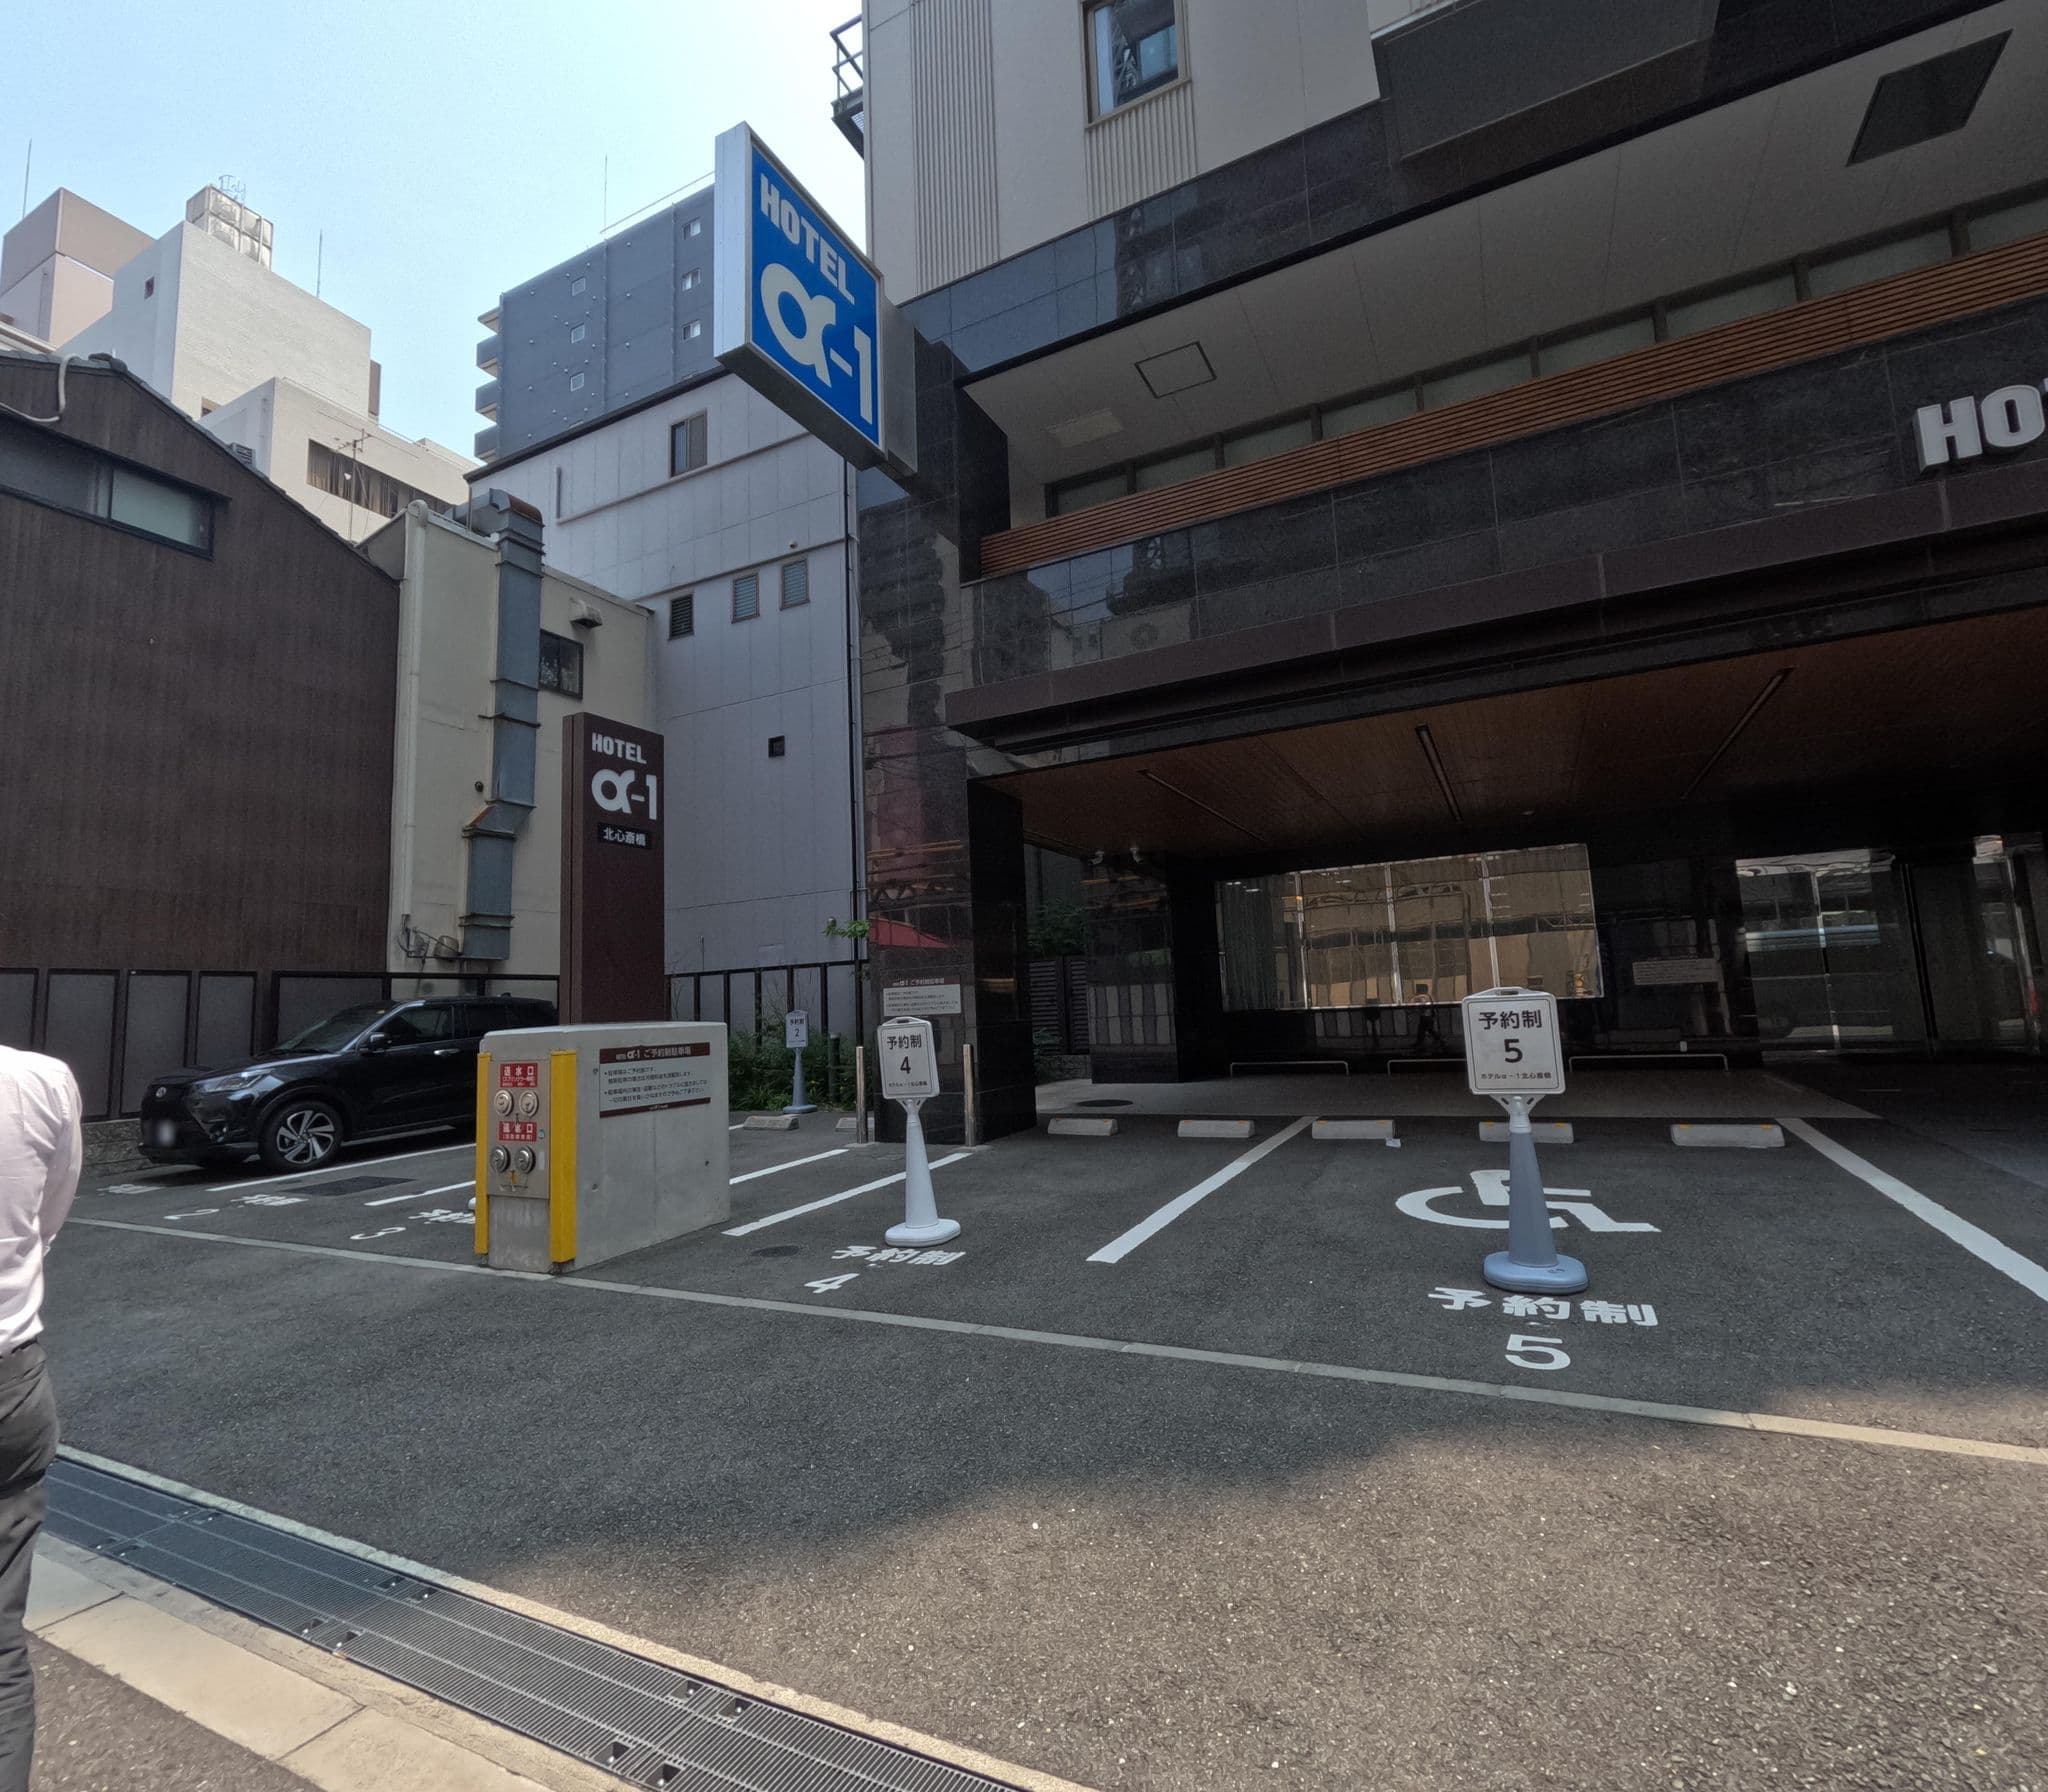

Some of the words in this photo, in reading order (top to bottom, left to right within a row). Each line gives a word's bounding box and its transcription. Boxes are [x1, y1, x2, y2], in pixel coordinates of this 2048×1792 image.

[760, 172, 856, 306] HOTEL
[1914, 378, 2048, 472] HO
[591, 731, 647, 764] HOTEL
[1478, 1009, 1543, 1030] 予約制
[886, 1034, 922, 1050] 予約制
[1504, 1038, 1523, 1064] 5
[899, 1056, 911, 1075] 4
[350, 1226, 407, 1240] 3
[803, 1273, 860, 1294] 4
[1427, 1287, 1660, 1327] 予約制
[1505, 1334, 1571, 1371] 5
